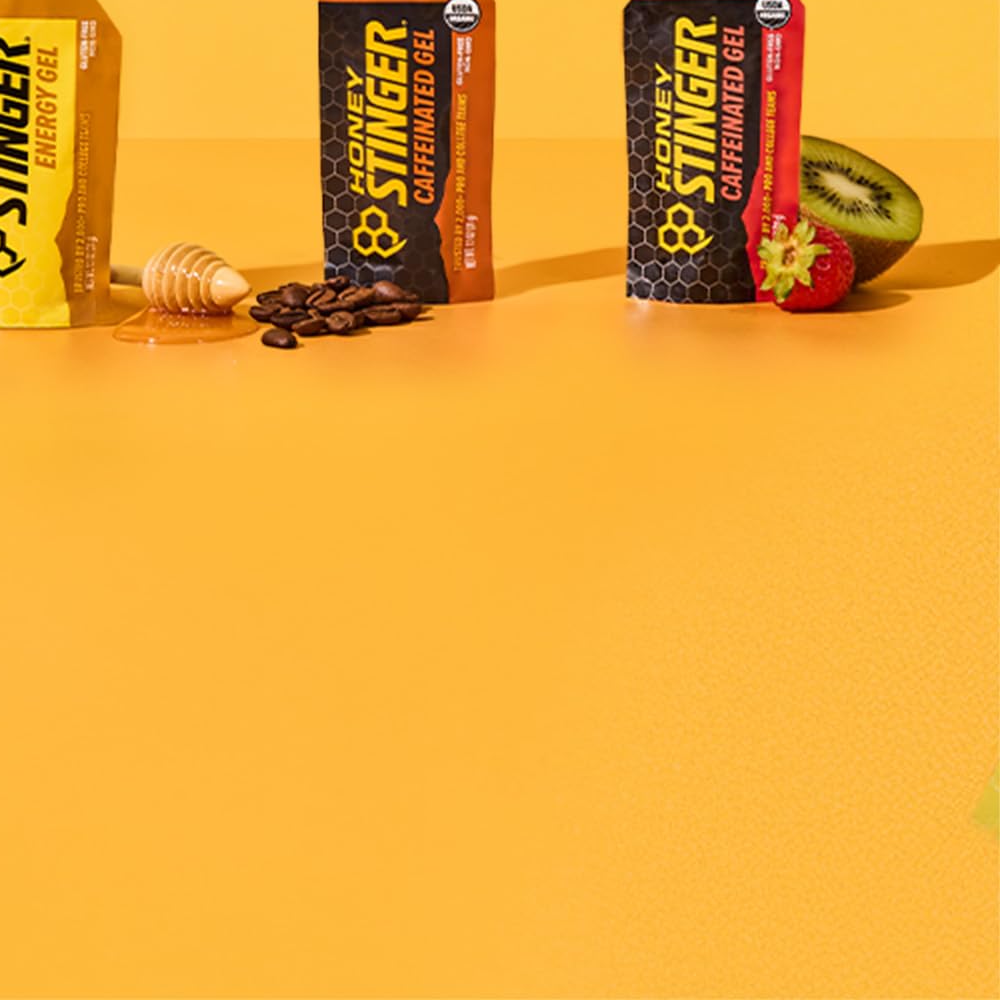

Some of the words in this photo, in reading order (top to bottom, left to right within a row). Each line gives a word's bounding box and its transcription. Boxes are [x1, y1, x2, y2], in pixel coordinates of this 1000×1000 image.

[37, 46, 58, 83] GEL
[413, 29, 435, 66] GEL
[723, 25, 745, 62] GEL
[35, 86, 58, 170] ENERGY
[346, 65, 365, 195] HONEY
[365, 20, 408, 207] STINGER
[413, 69, 435, 205] CAFFEINATED
[654, 62, 672, 191] HONEY
[673, 16, 717, 204] STINGER
[721, 65, 744, 201] CAFFEINATED
